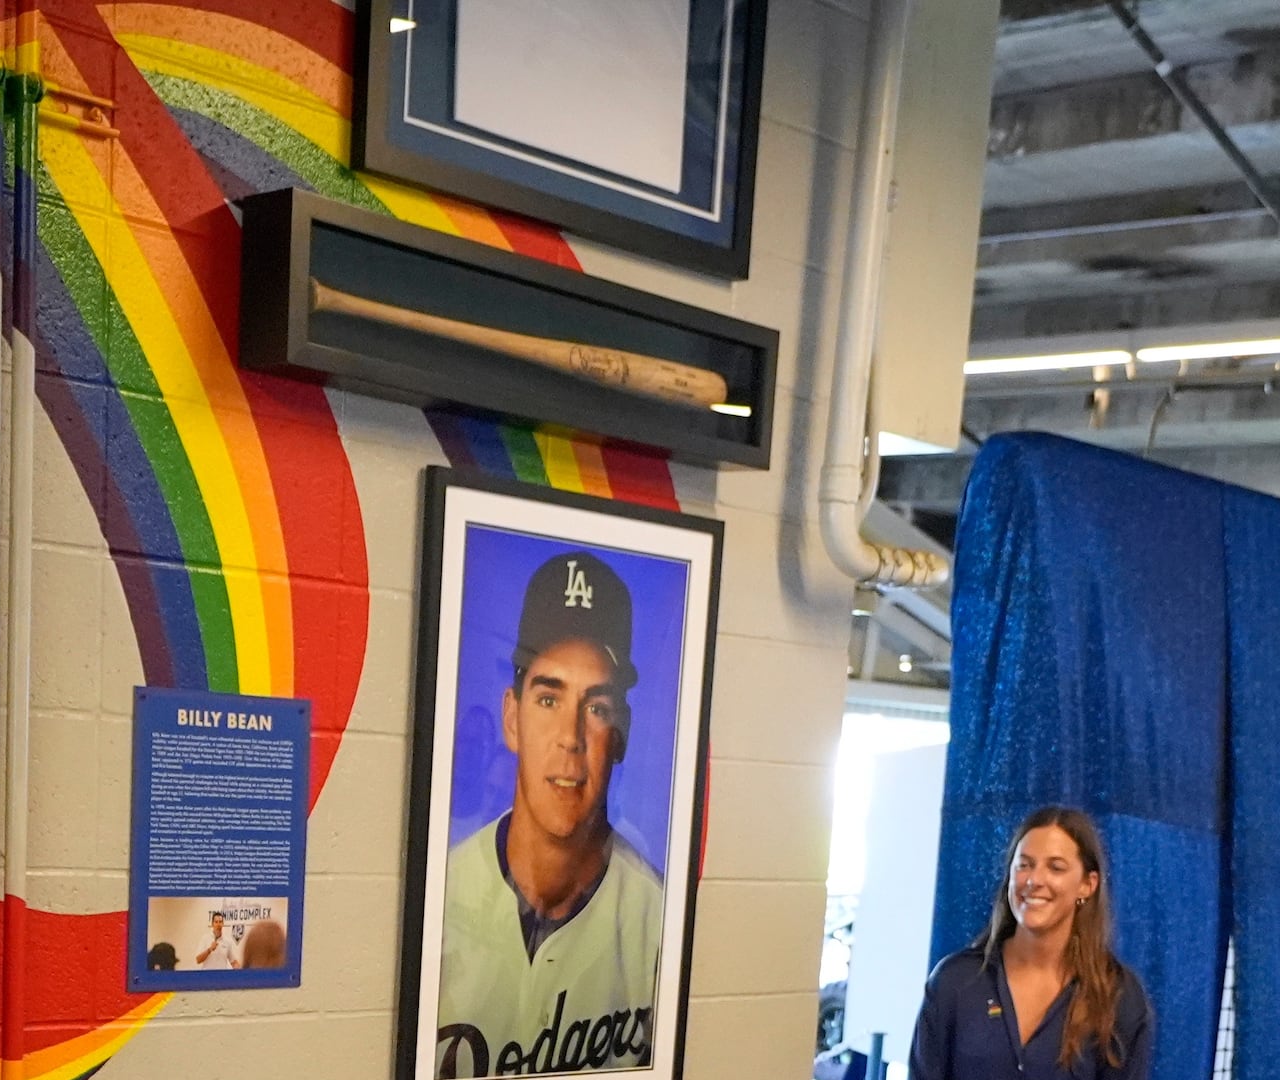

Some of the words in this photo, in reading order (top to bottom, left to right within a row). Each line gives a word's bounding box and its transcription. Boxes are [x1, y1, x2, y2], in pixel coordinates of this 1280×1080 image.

[564, 559, 593, 610] LA
[177, 708, 222, 728] BILLY
[226, 711, 272, 732] BEAN
[239, 907, 272, 921] COMPLEX
